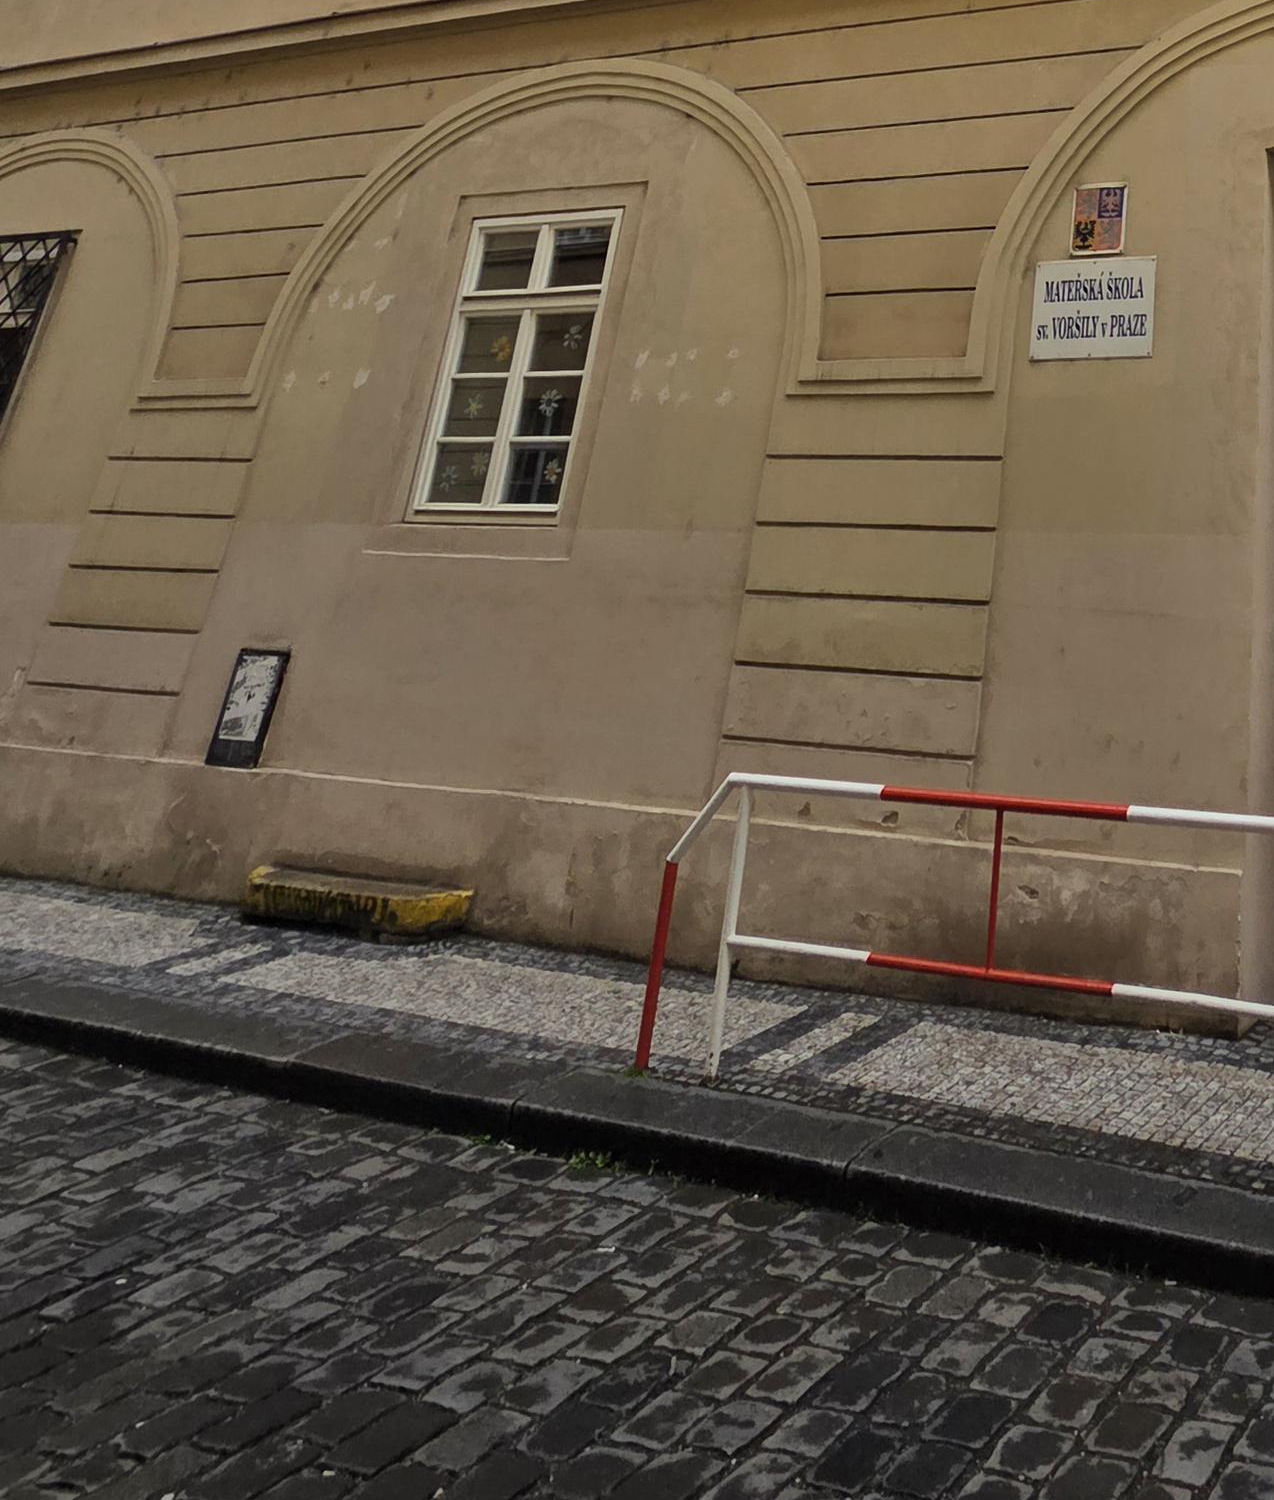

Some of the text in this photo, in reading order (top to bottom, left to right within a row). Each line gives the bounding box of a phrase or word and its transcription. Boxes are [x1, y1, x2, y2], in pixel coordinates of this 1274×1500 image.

[1043, 271, 1144, 303] MATEŘSKÁ ŠKOLA
[1036, 310, 1147, 341] sv. VORŠILY v PRAZE
